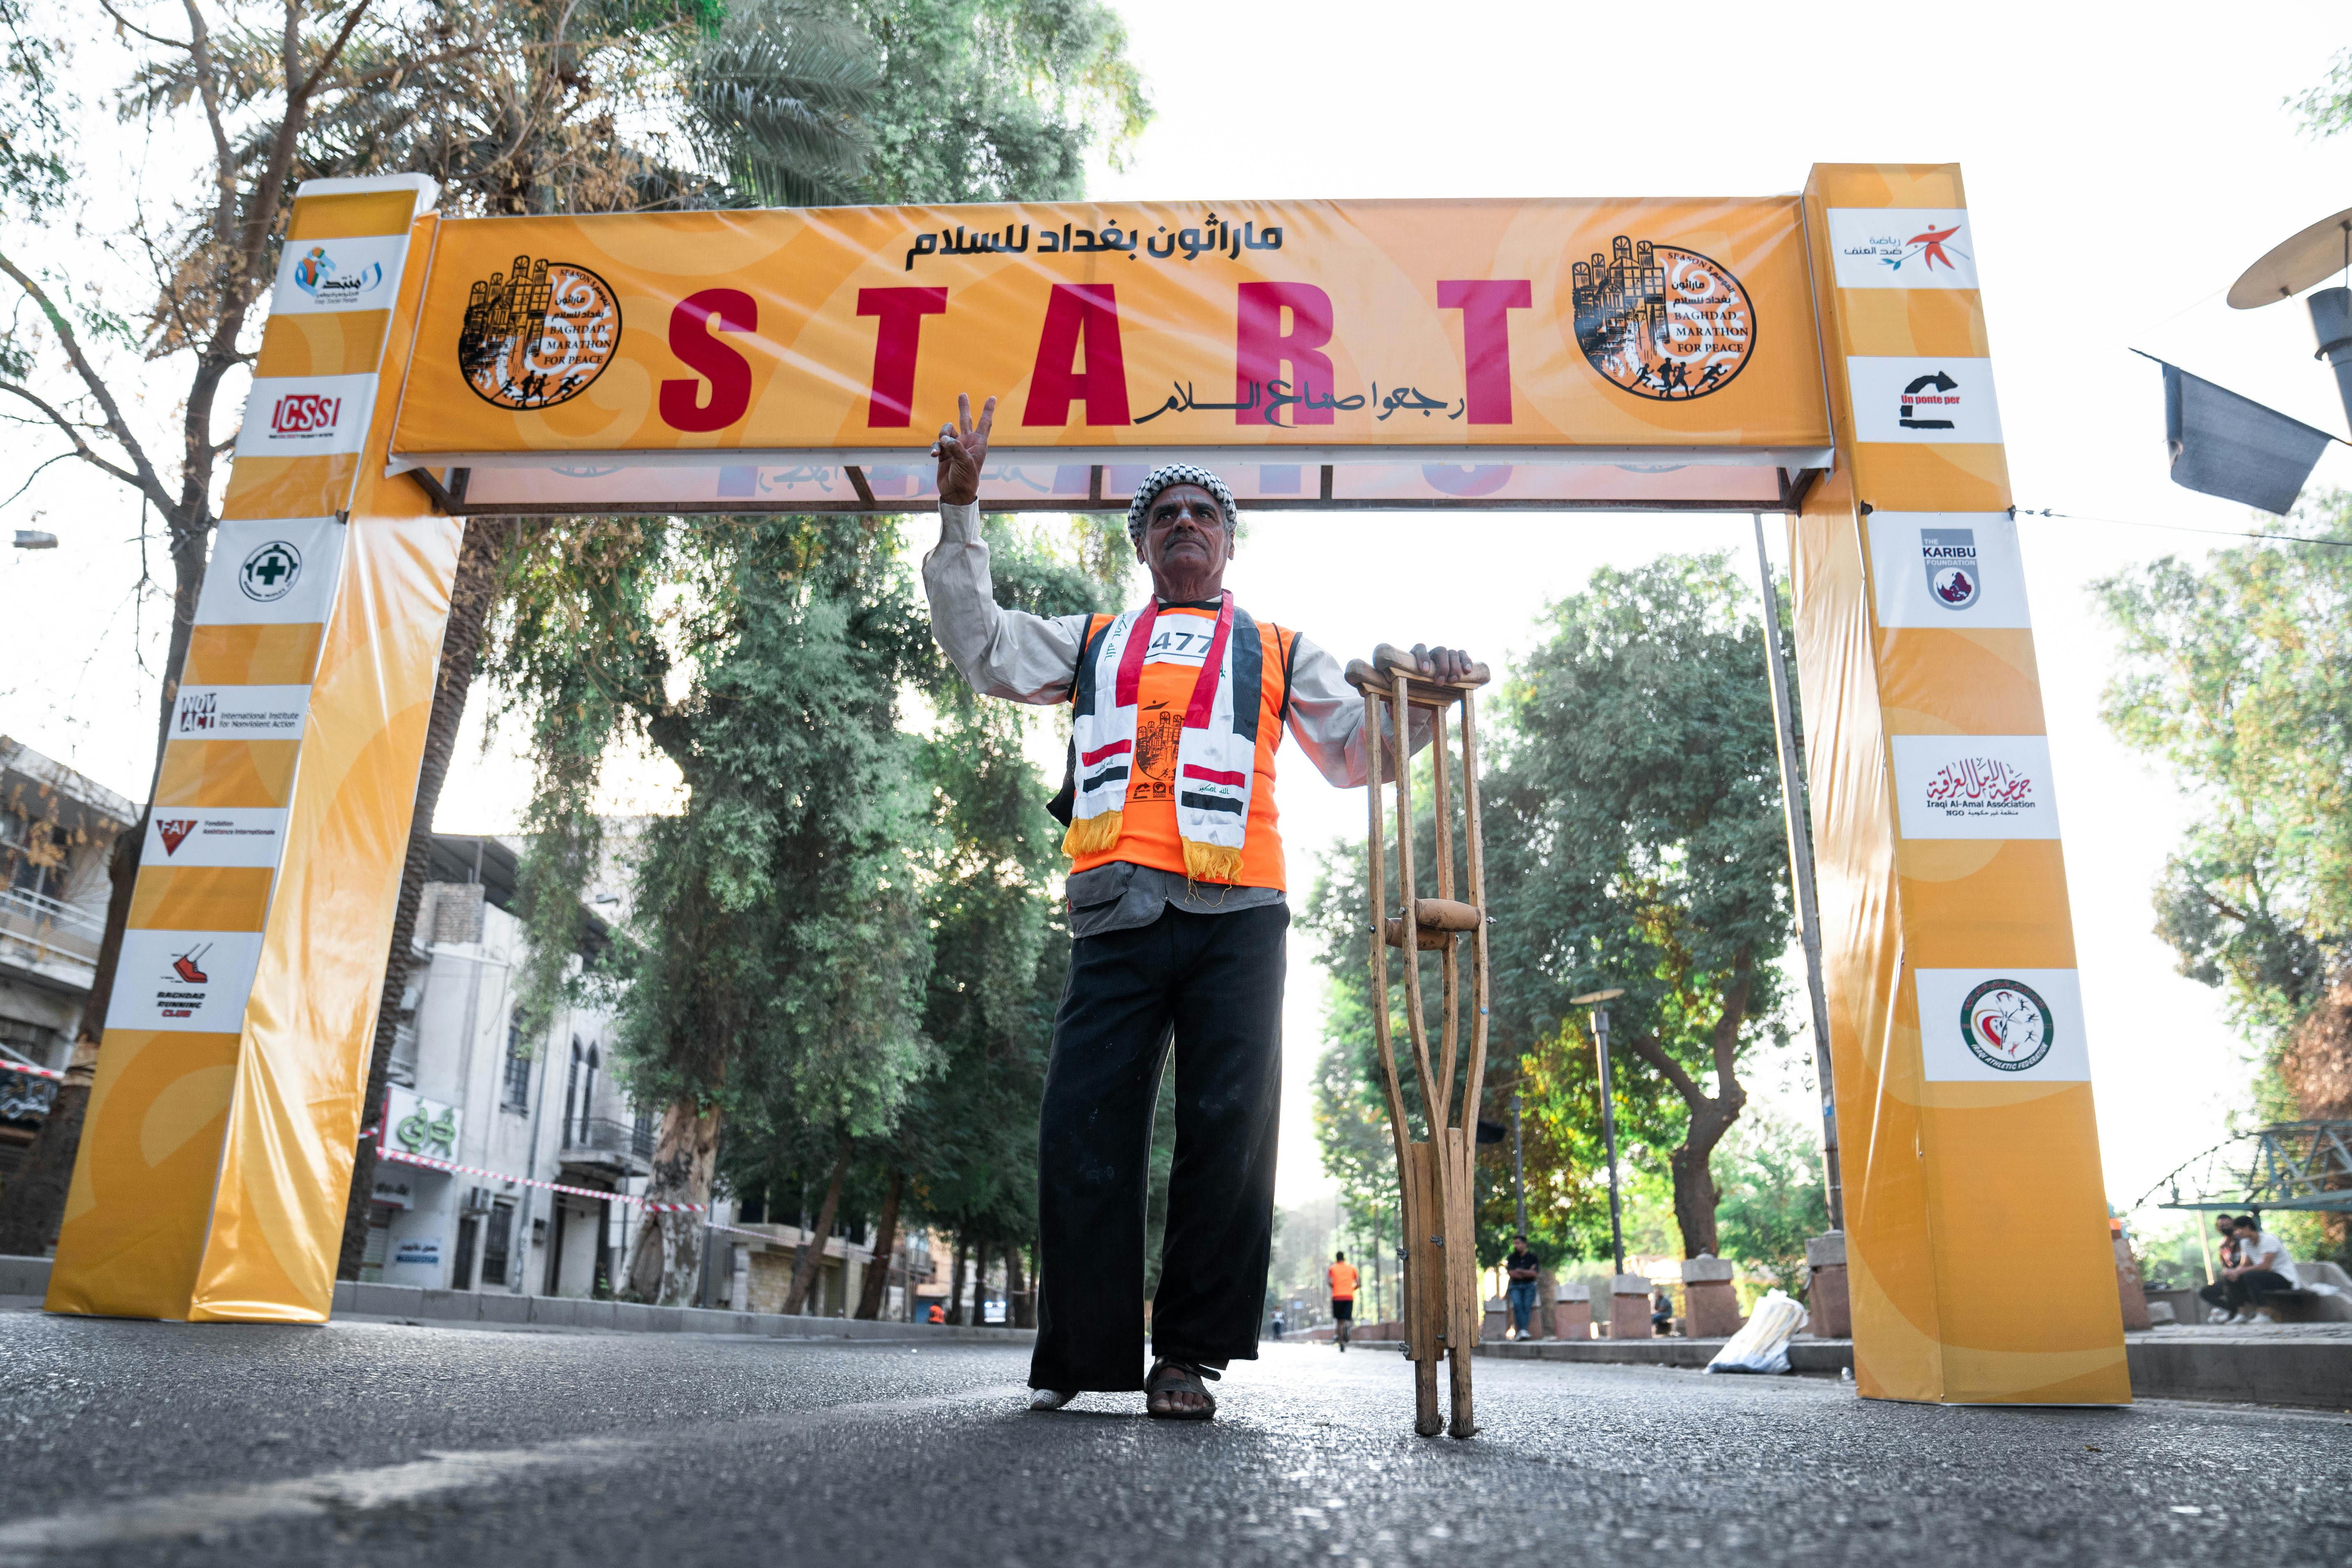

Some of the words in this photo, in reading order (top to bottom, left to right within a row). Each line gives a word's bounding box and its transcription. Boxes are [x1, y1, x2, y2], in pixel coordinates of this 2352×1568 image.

[1037, 219, 1138, 261] بغداد
[1147, 212, 1283, 261] ماراثون
[1869, 236, 1901, 246] رياضة
[905, 224, 1030, 272] للسلام
[1845, 247, 1876, 255] العنف
[1668, 252, 1707, 268] SEASON
[560, 269, 592, 283] SEASON
[1671, 278, 1705, 291] ماراثون
[555, 294, 586, 306] ماراثون
[1673, 296, 1704, 308] للسلام
[1706, 295, 1732, 306] بغداد
[551, 311, 581, 322] للسلام
[581, 309, 604, 320] بغداد
[1674, 311, 1736, 320] BAGHDAD
[549, 325, 605, 335] BAGHDAD
[1676, 327, 1748, 336] MARATHON
[547, 340, 612, 350] MARATHON
[1678, 344, 1701, 352] FOR
[1705, 344, 1744, 352] PEACE
[544, 356, 565, 365] FOR
[568, 355, 604, 364] PEACE
[659, 280, 1532, 432] START
[1901, 395, 1914, 404] Un
[1915, 396, 1942, 405] ponte
[1944, 396, 1960, 405] per
[271, 397, 342, 430] ICSSI
[1923, 547, 1977, 558] KARIBU
[1147, 632, 1213, 653] 477
[181, 712, 215, 732] ACT
[1926, 801, 1947, 809] Iraqi
[161, 820, 188, 835] FAI
[1984, 1057, 2017, 1070] ATHLETIC
